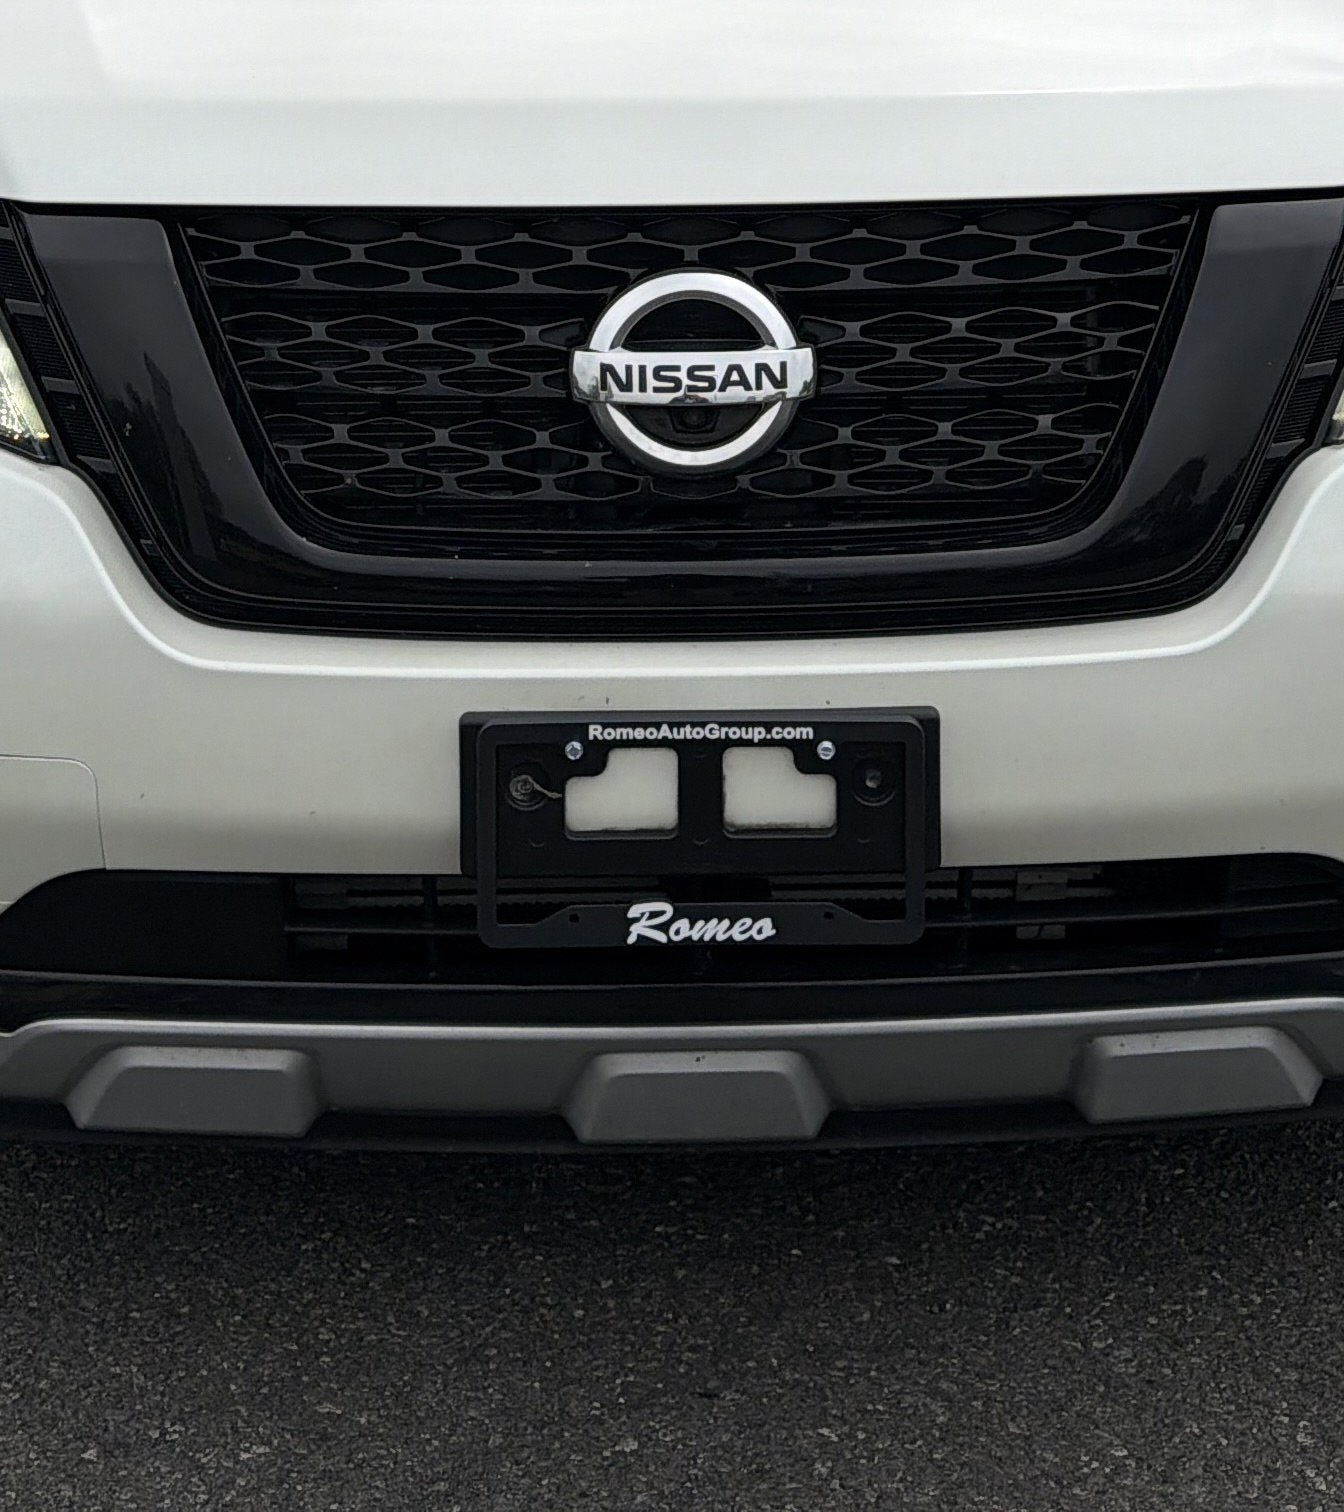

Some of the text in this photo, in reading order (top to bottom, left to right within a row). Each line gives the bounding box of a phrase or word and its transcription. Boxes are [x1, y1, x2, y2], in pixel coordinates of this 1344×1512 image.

[599, 360, 789, 394] NISSAN
[588, 723, 814, 743] RomeoAutoGroup.com
[626, 902, 777, 946] Romeo
